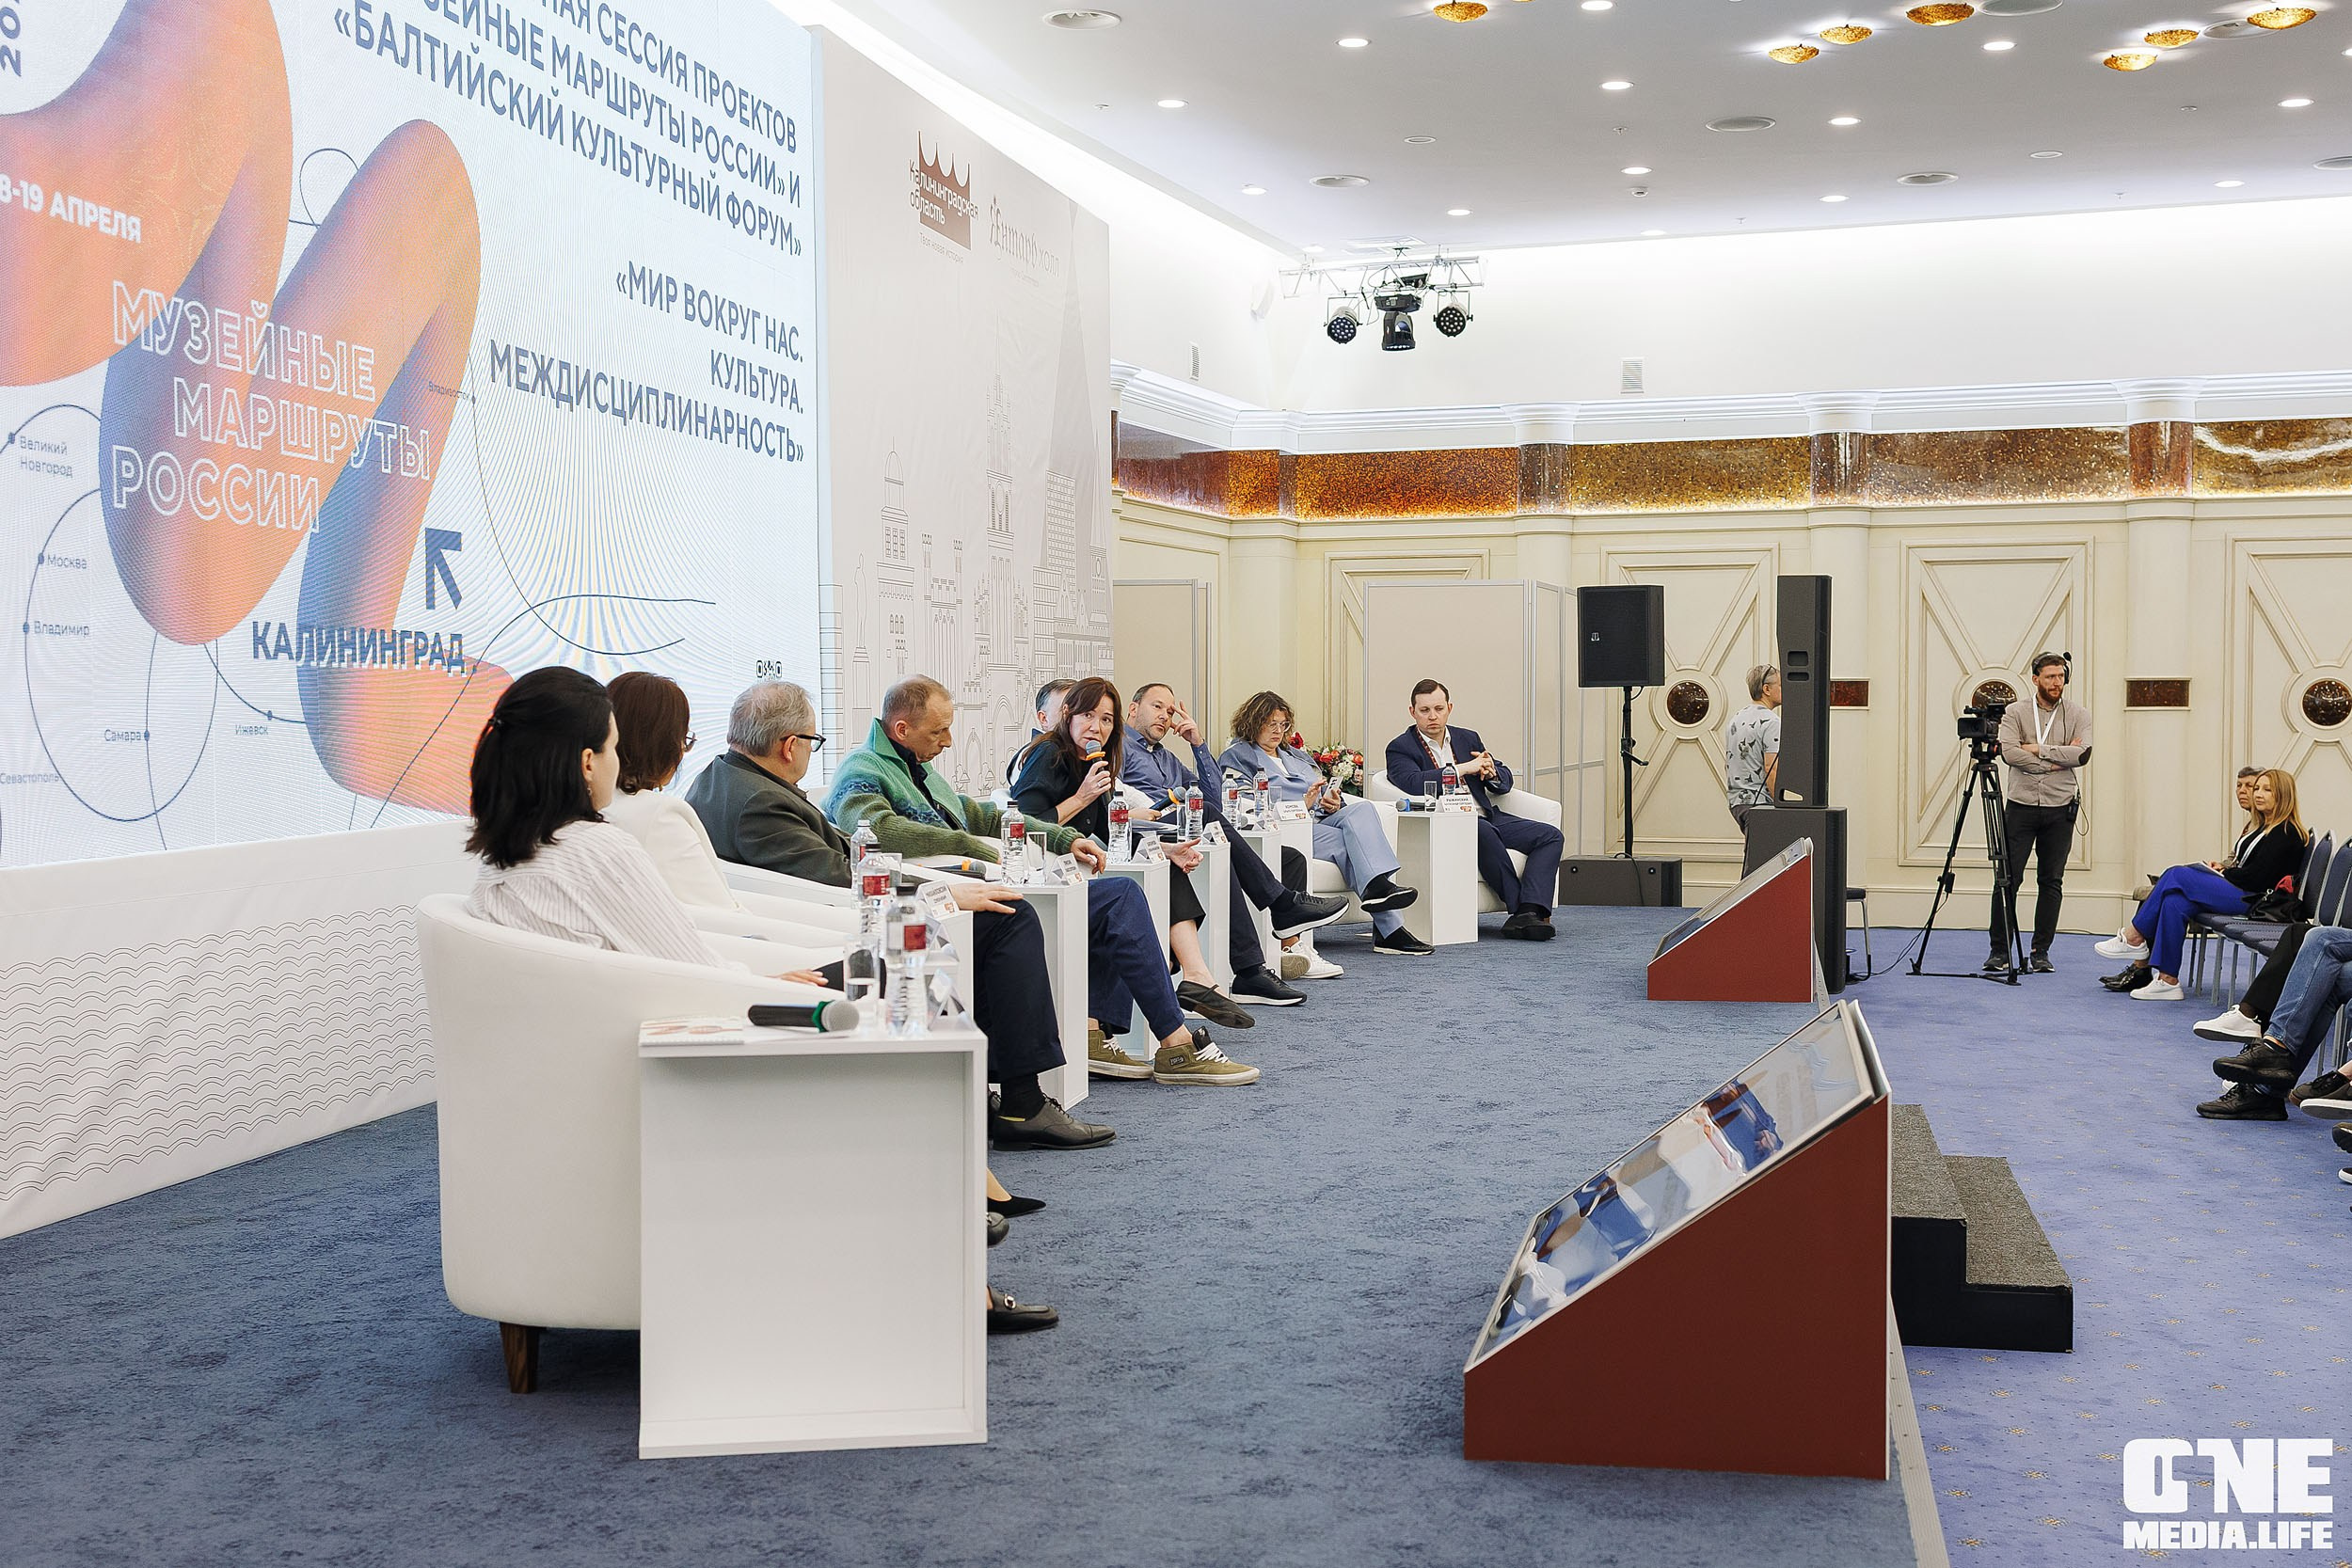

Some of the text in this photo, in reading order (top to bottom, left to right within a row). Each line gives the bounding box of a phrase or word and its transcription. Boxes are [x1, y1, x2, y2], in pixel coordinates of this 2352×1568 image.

[0, 0, 22, 78] 20
[423, 0, 802, 208] ЕЙНЫЕ МАРШРУТЫ РОССИИ» И
[541, 0, 798, 153] АЯ СЕССИЯ ПРОЕКТОВ
[334, 0, 802, 257] «БАЛТИЙСКИЙ КУЛЬТУРНЫЙ ФОРУМ»
[49, 190, 142, 244] АПРЕЛЯ
[909, 158, 978, 221] Калининградская
[909, 187, 946, 225] область
[112, 280, 376, 406] МУЗЕЙНЫЕ
[616, 260, 804, 363] «МИР ВОКРУГ НАС.
[489, 339, 805, 462] МЕЖДИСЦИПЛИНАРНОСТЬ»
[710, 349, 804, 414] КУЛЬТУРА.
[20, 435, 68, 455] Великий
[172, 375, 432, 481] МАРШРУТЫ
[20, 456, 72, 478] Новгород
[111, 444, 321, 534] РОССИИ
[47, 552, 87, 570] Москва
[33, 620, 90, 637] Владимир
[252, 621, 465, 675] КАЛИНИНГРАД
[103, 728, 142, 743] Самара
[235, 723, 269, 736] Ижевск
[0, 772, 60, 784] Севастополь
